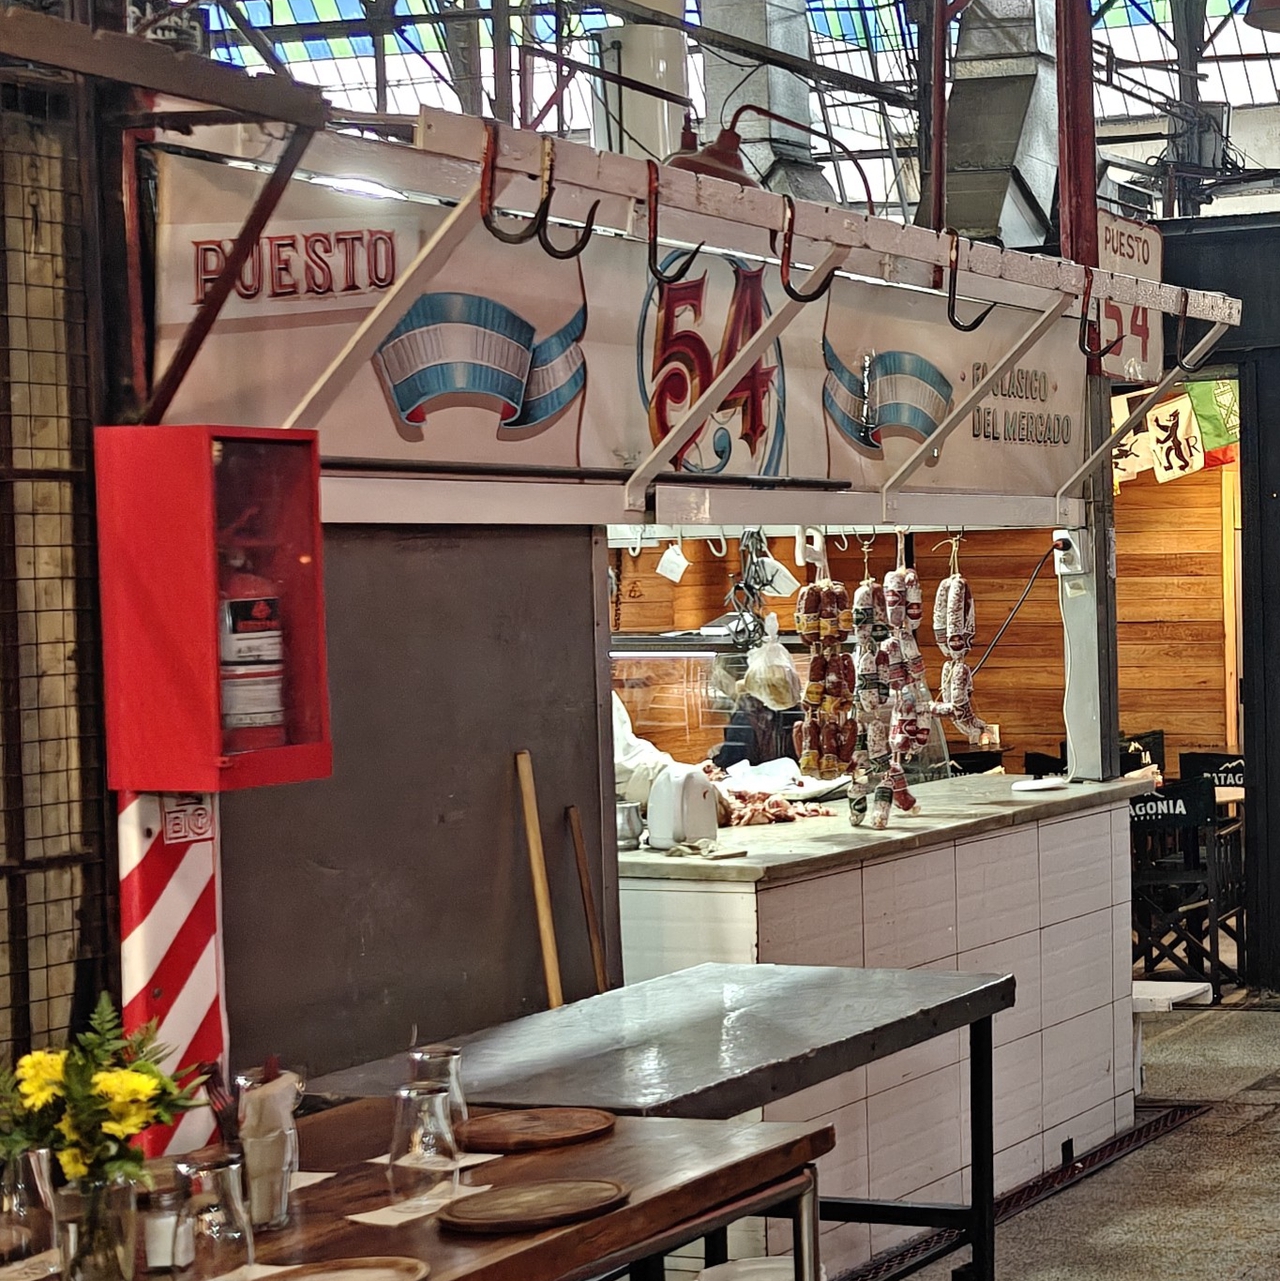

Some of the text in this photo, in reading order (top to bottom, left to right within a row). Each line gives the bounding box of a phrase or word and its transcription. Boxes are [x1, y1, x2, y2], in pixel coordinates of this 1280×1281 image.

[191, 229, 396, 306] PUESTO
[1104, 226, 1150, 265] PUESTO
[1104, 299, 1149, 363] 54
[648, 265, 779, 472] 54
[971, 405, 1071, 447] DEL MERCADO
[1203, 773, 1244, 785] ATAG
